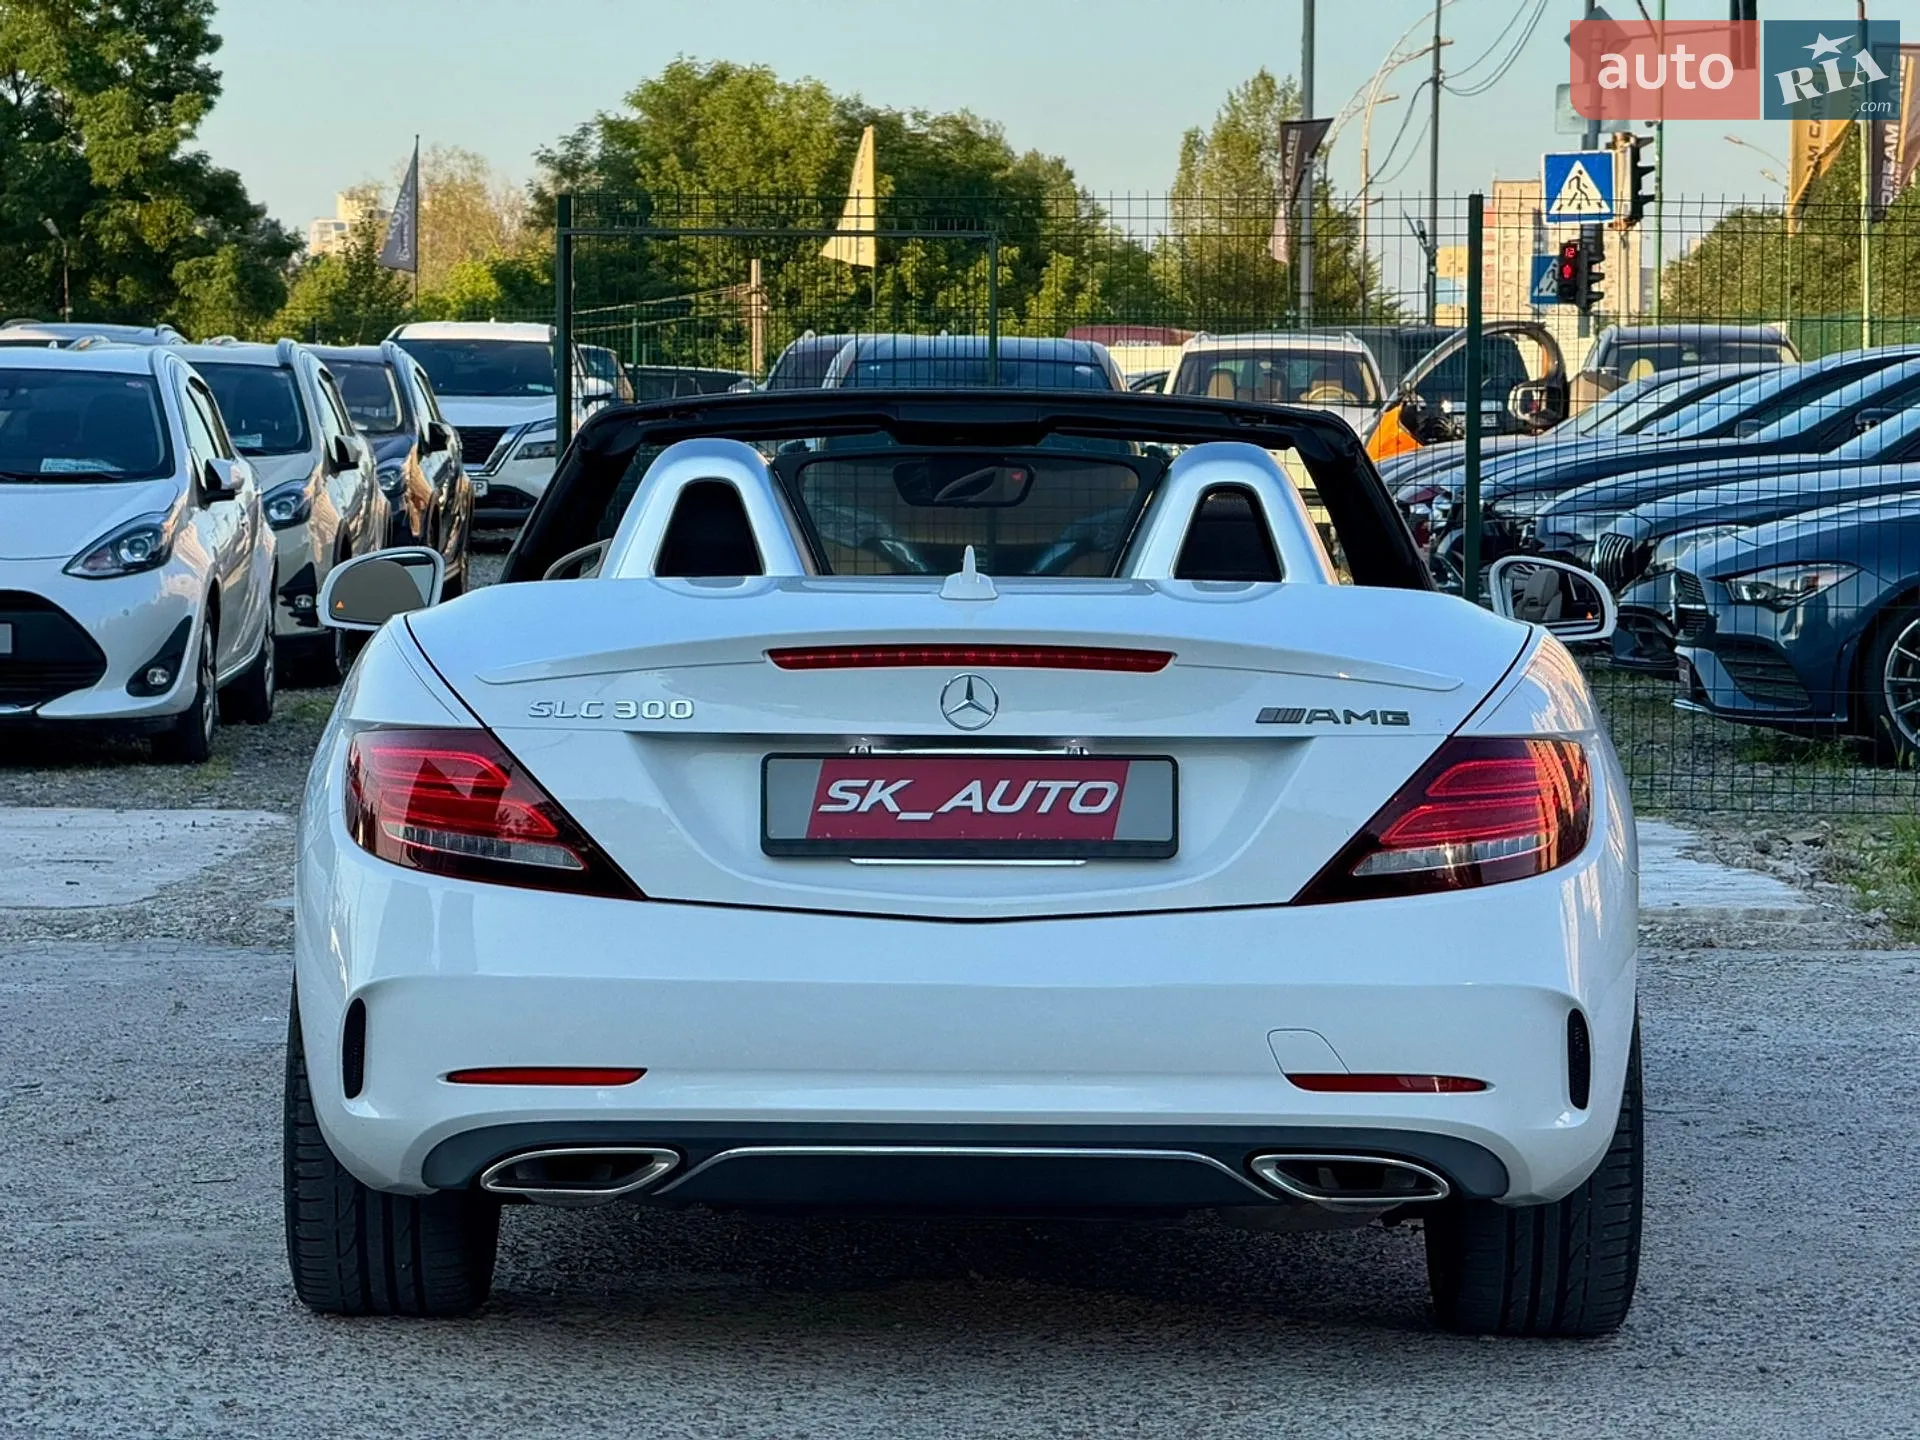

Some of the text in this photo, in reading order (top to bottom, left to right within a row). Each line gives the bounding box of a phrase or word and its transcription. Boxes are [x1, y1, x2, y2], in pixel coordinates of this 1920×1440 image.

[527, 699, 695, 720] SLC 300
[1305, 708, 1411, 726] AMG
[817, 778, 1120, 821] SK_AUTO
